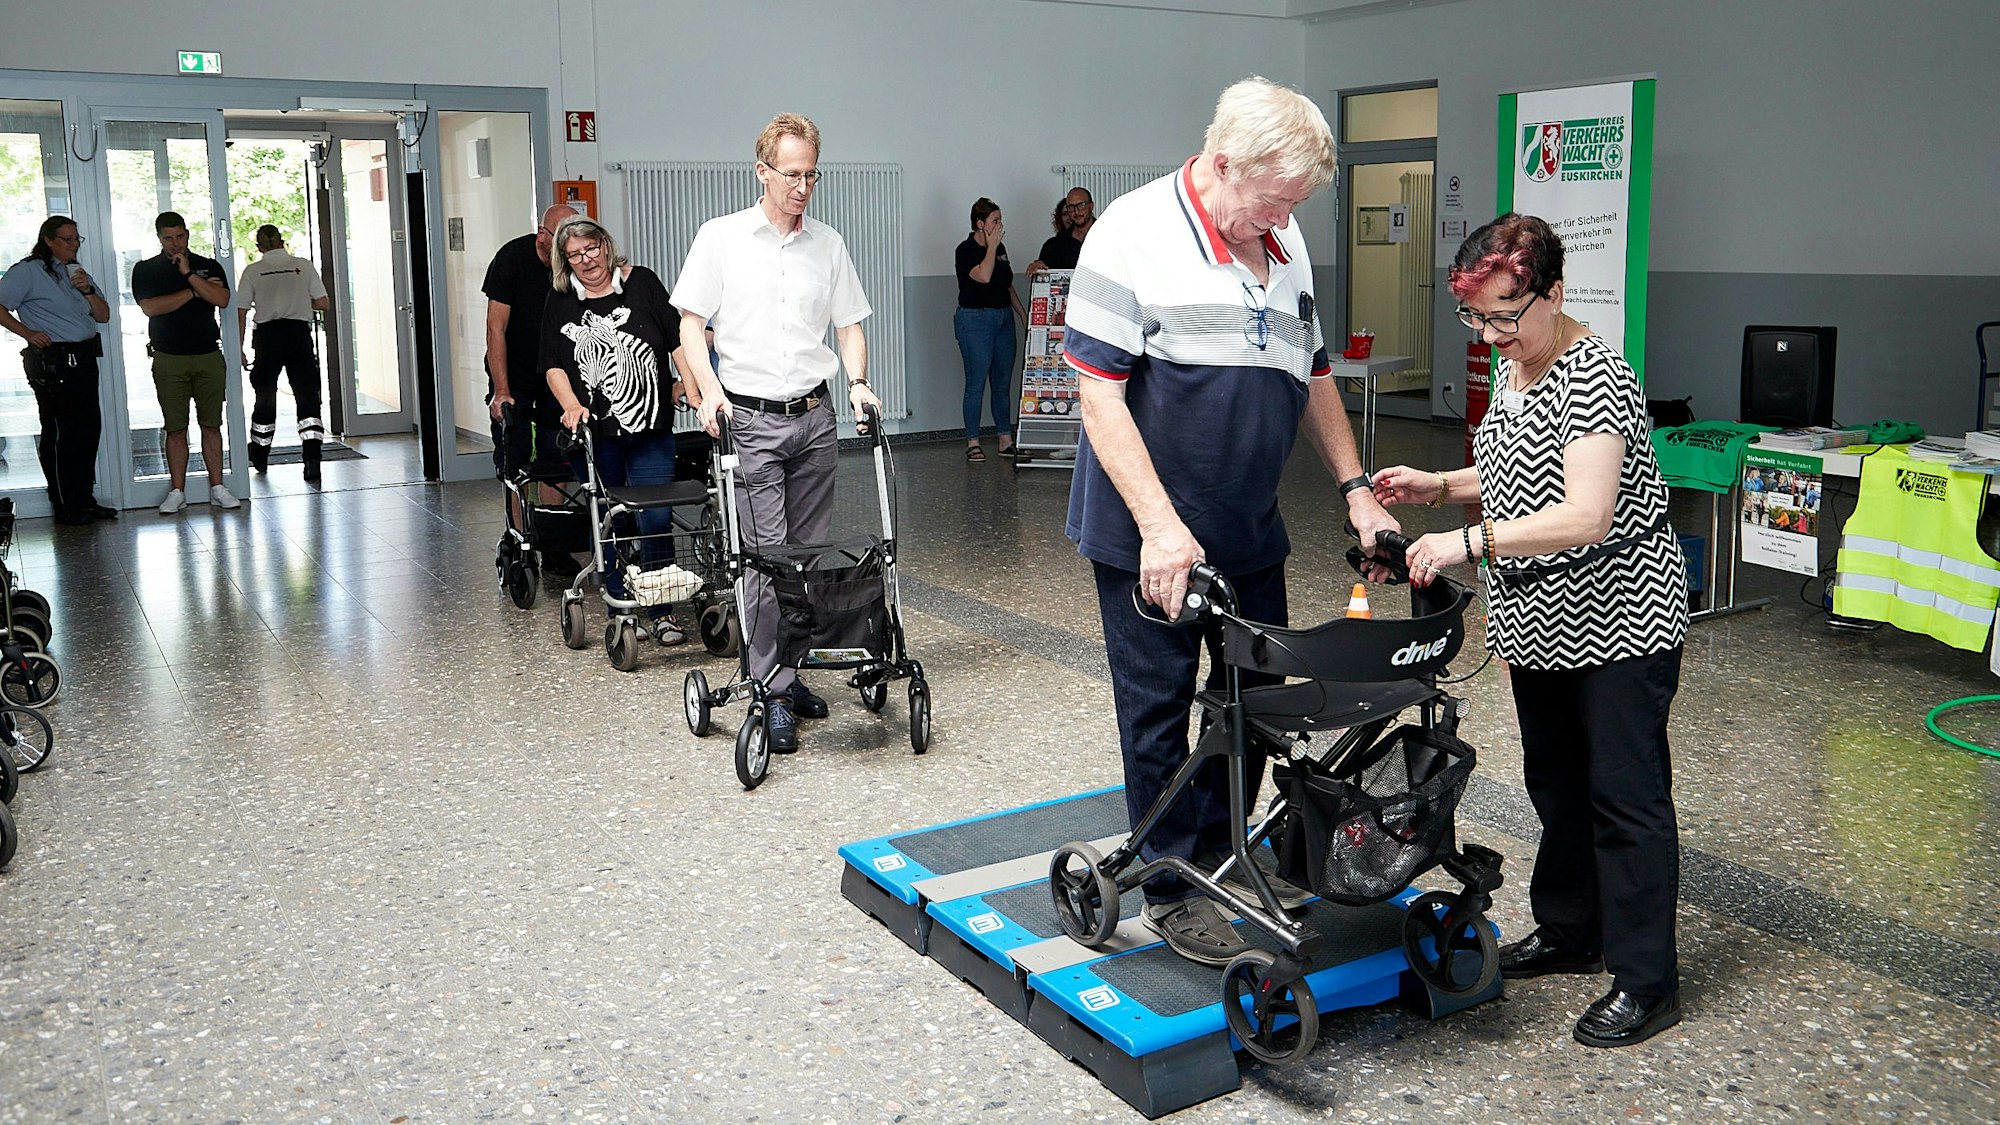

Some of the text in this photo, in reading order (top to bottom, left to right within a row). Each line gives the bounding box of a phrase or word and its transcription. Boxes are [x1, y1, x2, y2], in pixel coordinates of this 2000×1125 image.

[1600, 115, 1624, 126] KREIS
[1563, 125, 1624, 145] VERKEHRS
[1562, 144, 1605, 162] WACHT
[1561, 170, 1623, 181] EUSKIRCHEN
[1563, 219, 1575, 228] für
[1577, 212, 1617, 226] Sicherheit
[1602, 227, 1612, 236] im
[1564, 242, 1605, 254] uskirchen
[1580, 287, 1589, 295] im
[1747, 455, 1776, 465] Sicherheit
[1788, 461, 1811, 470] Vorfahrt
[1391, 637, 1447, 666] drive
